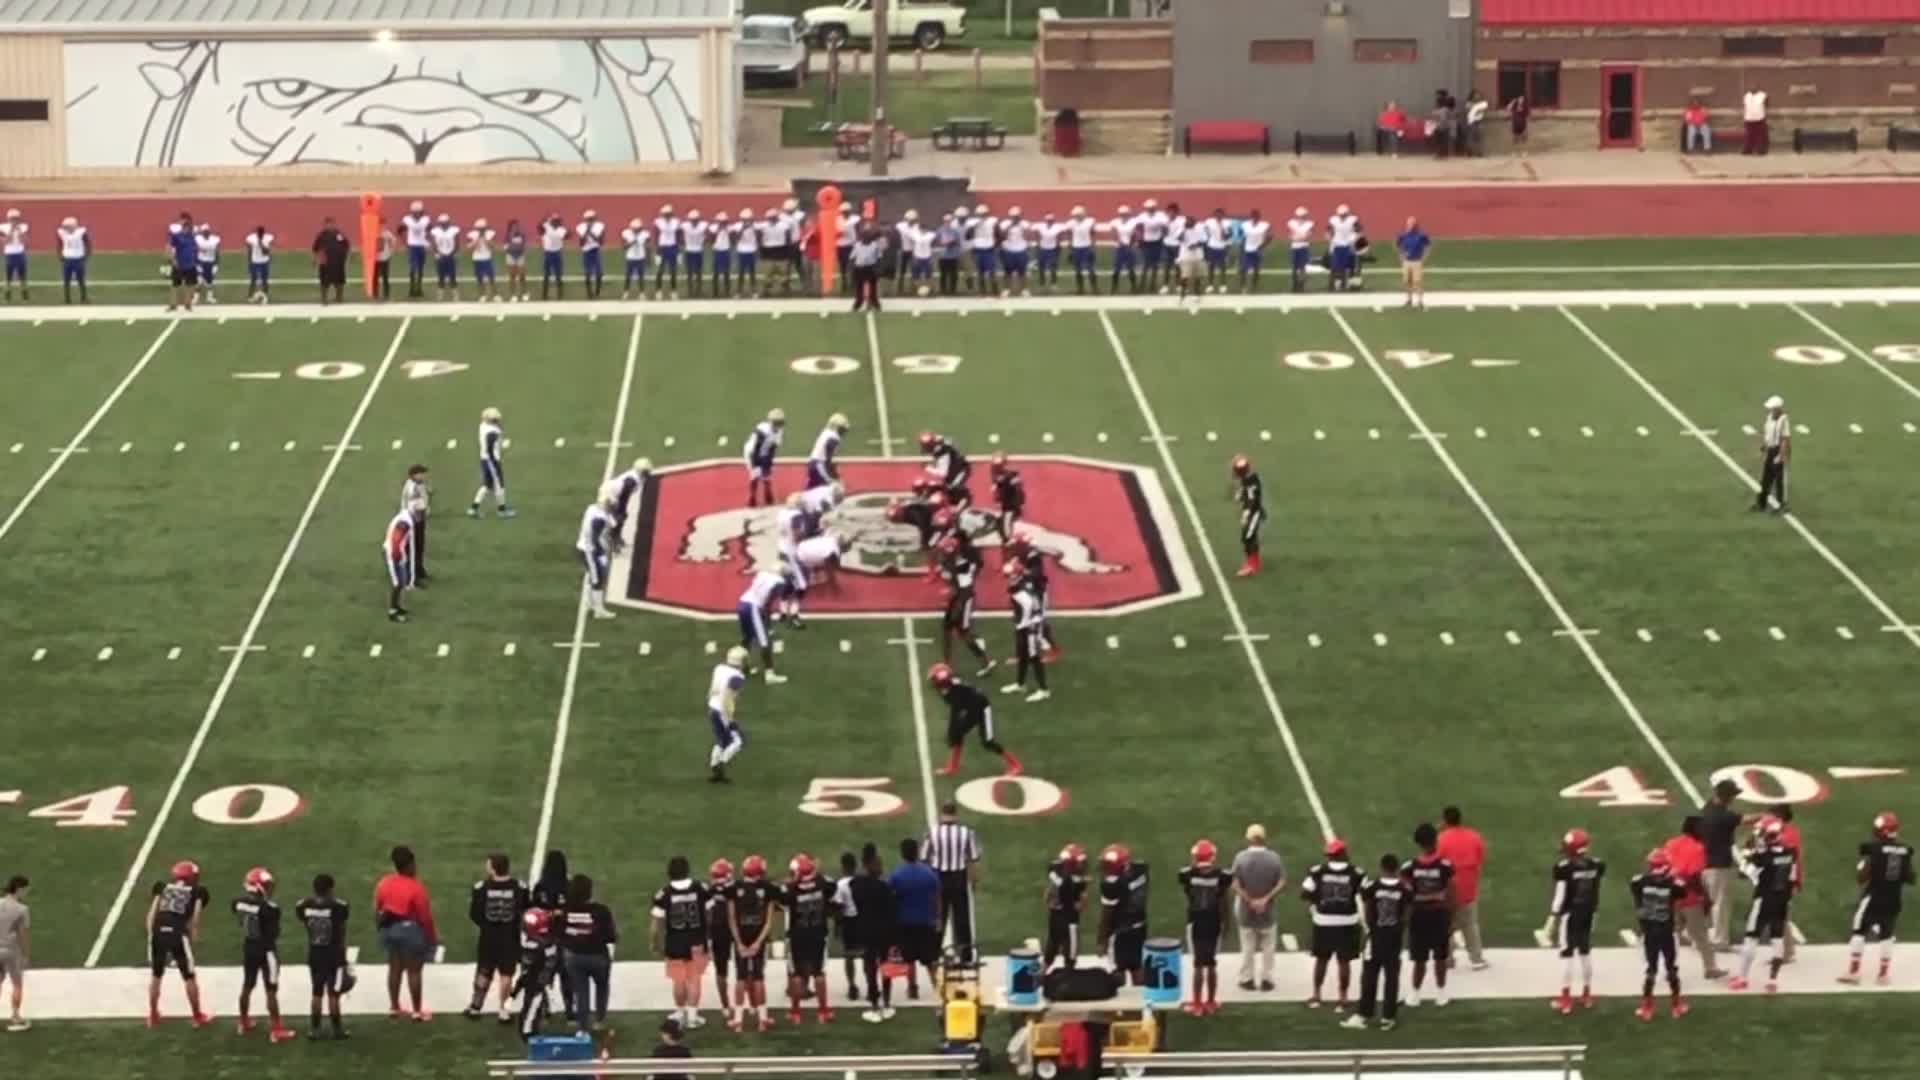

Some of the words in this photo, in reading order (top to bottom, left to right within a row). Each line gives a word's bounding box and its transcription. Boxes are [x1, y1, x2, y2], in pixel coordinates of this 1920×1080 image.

[295, 360, 470, 380] 40
[1282, 351, 1454, 370] 40
[27, 783, 307, 826] 40
[797, 775, 1068, 817] 50
[1559, 763, 1827, 806] 40
